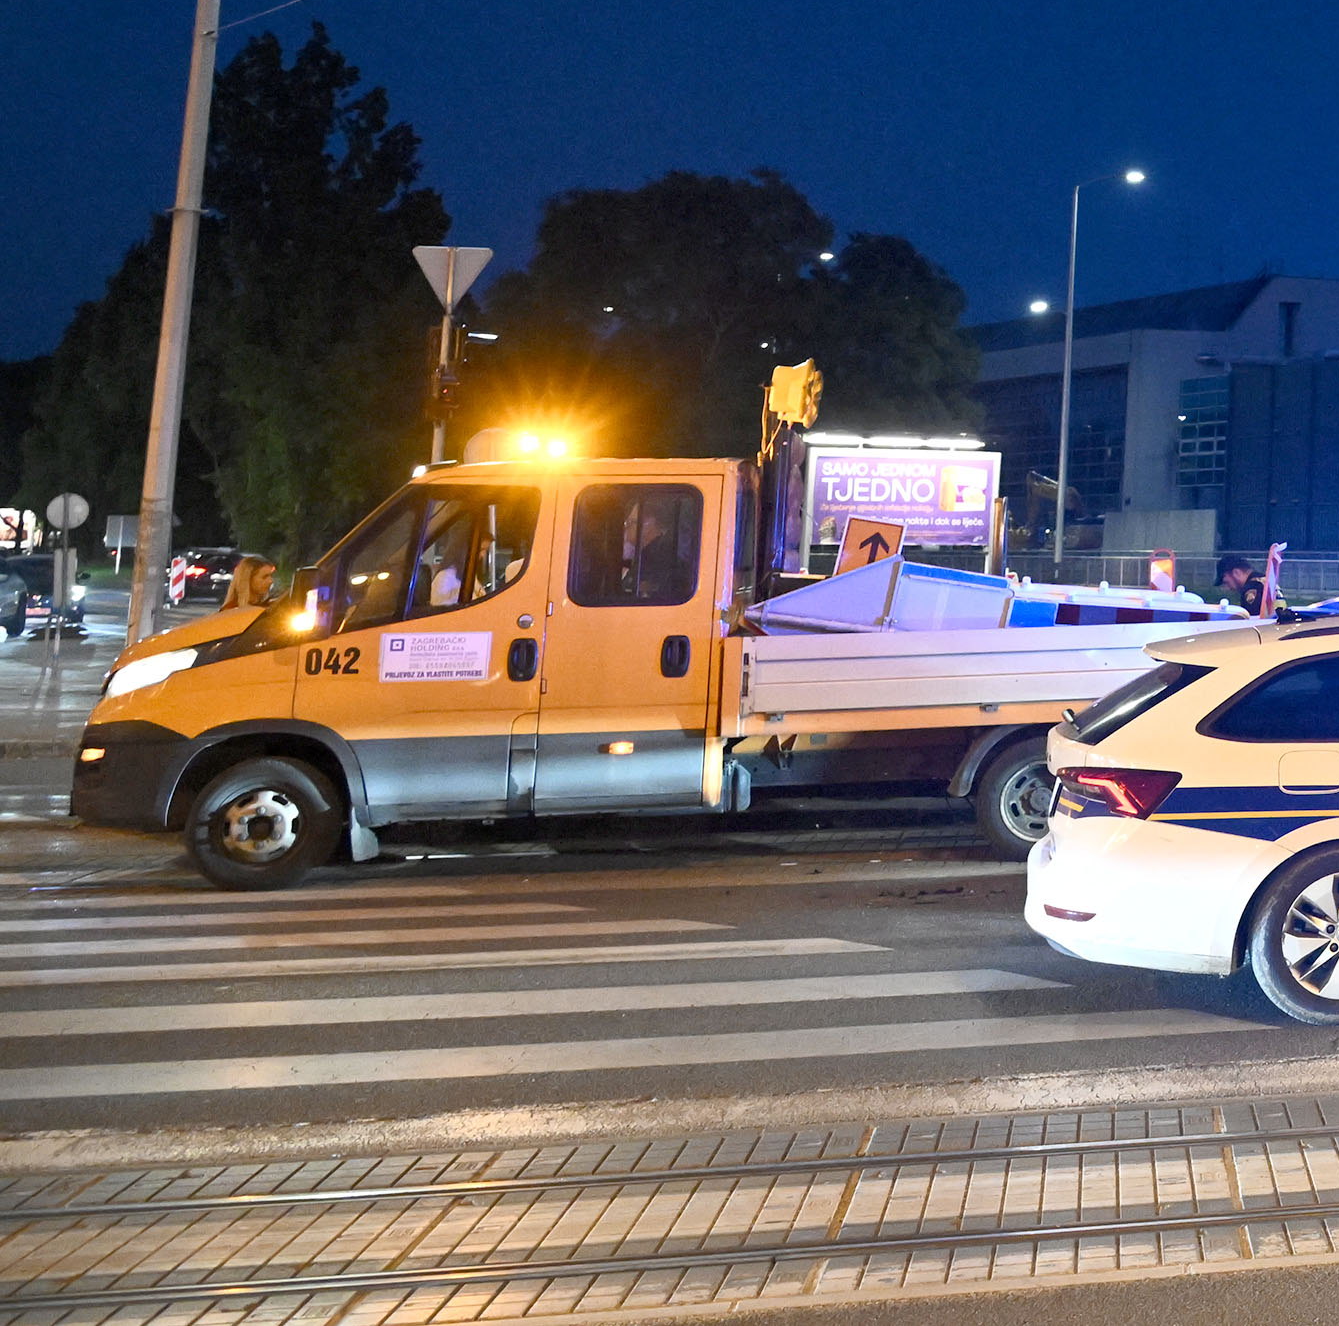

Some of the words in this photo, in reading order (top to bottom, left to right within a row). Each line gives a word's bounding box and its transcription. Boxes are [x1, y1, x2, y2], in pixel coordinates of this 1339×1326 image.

[821, 462, 868, 477] SAMO
[870, 463, 937, 478] JEDNOM
[821, 477, 936, 503] TJEDNO
[935, 517, 950, 526] dok
[411, 636, 466, 644] ZAGREBAČKI
[410, 644, 450, 652] HOLDING
[305, 647, 361, 675] 042
[385, 671, 415, 679] PRIJEVOZ
[455, 669, 483, 677] POTREBE
